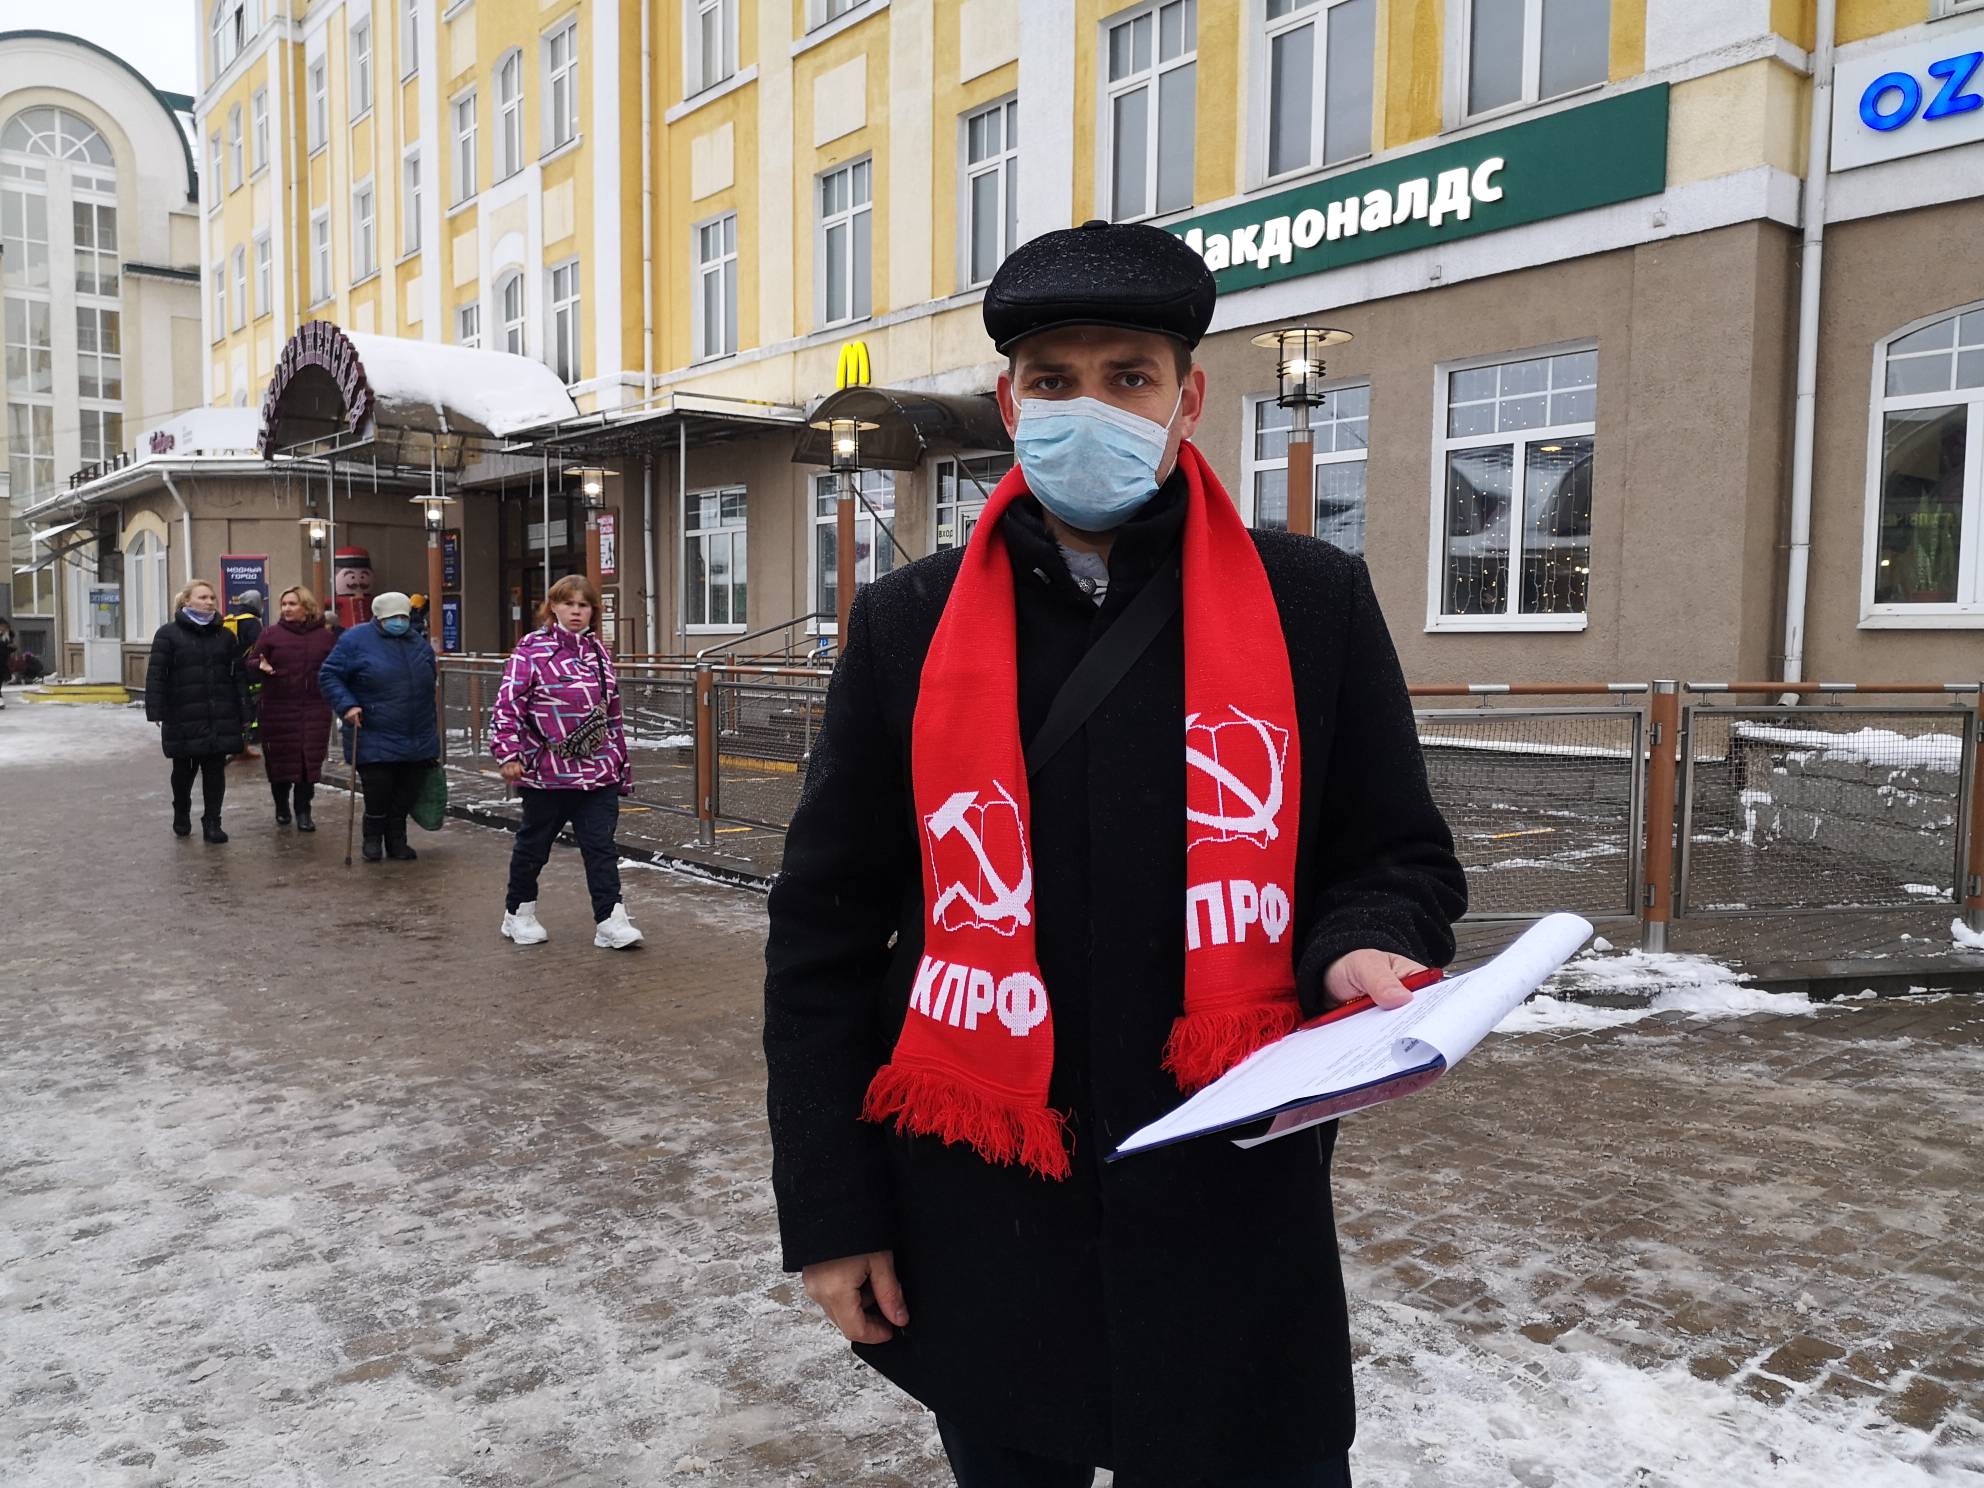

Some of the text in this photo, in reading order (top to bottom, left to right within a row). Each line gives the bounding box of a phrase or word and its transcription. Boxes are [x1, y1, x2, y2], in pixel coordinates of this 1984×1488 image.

[1859, 51, 1984, 132] OZ
[1186, 880, 1290, 950] ПРФ
[910, 955, 1048, 1036] КПРФ
